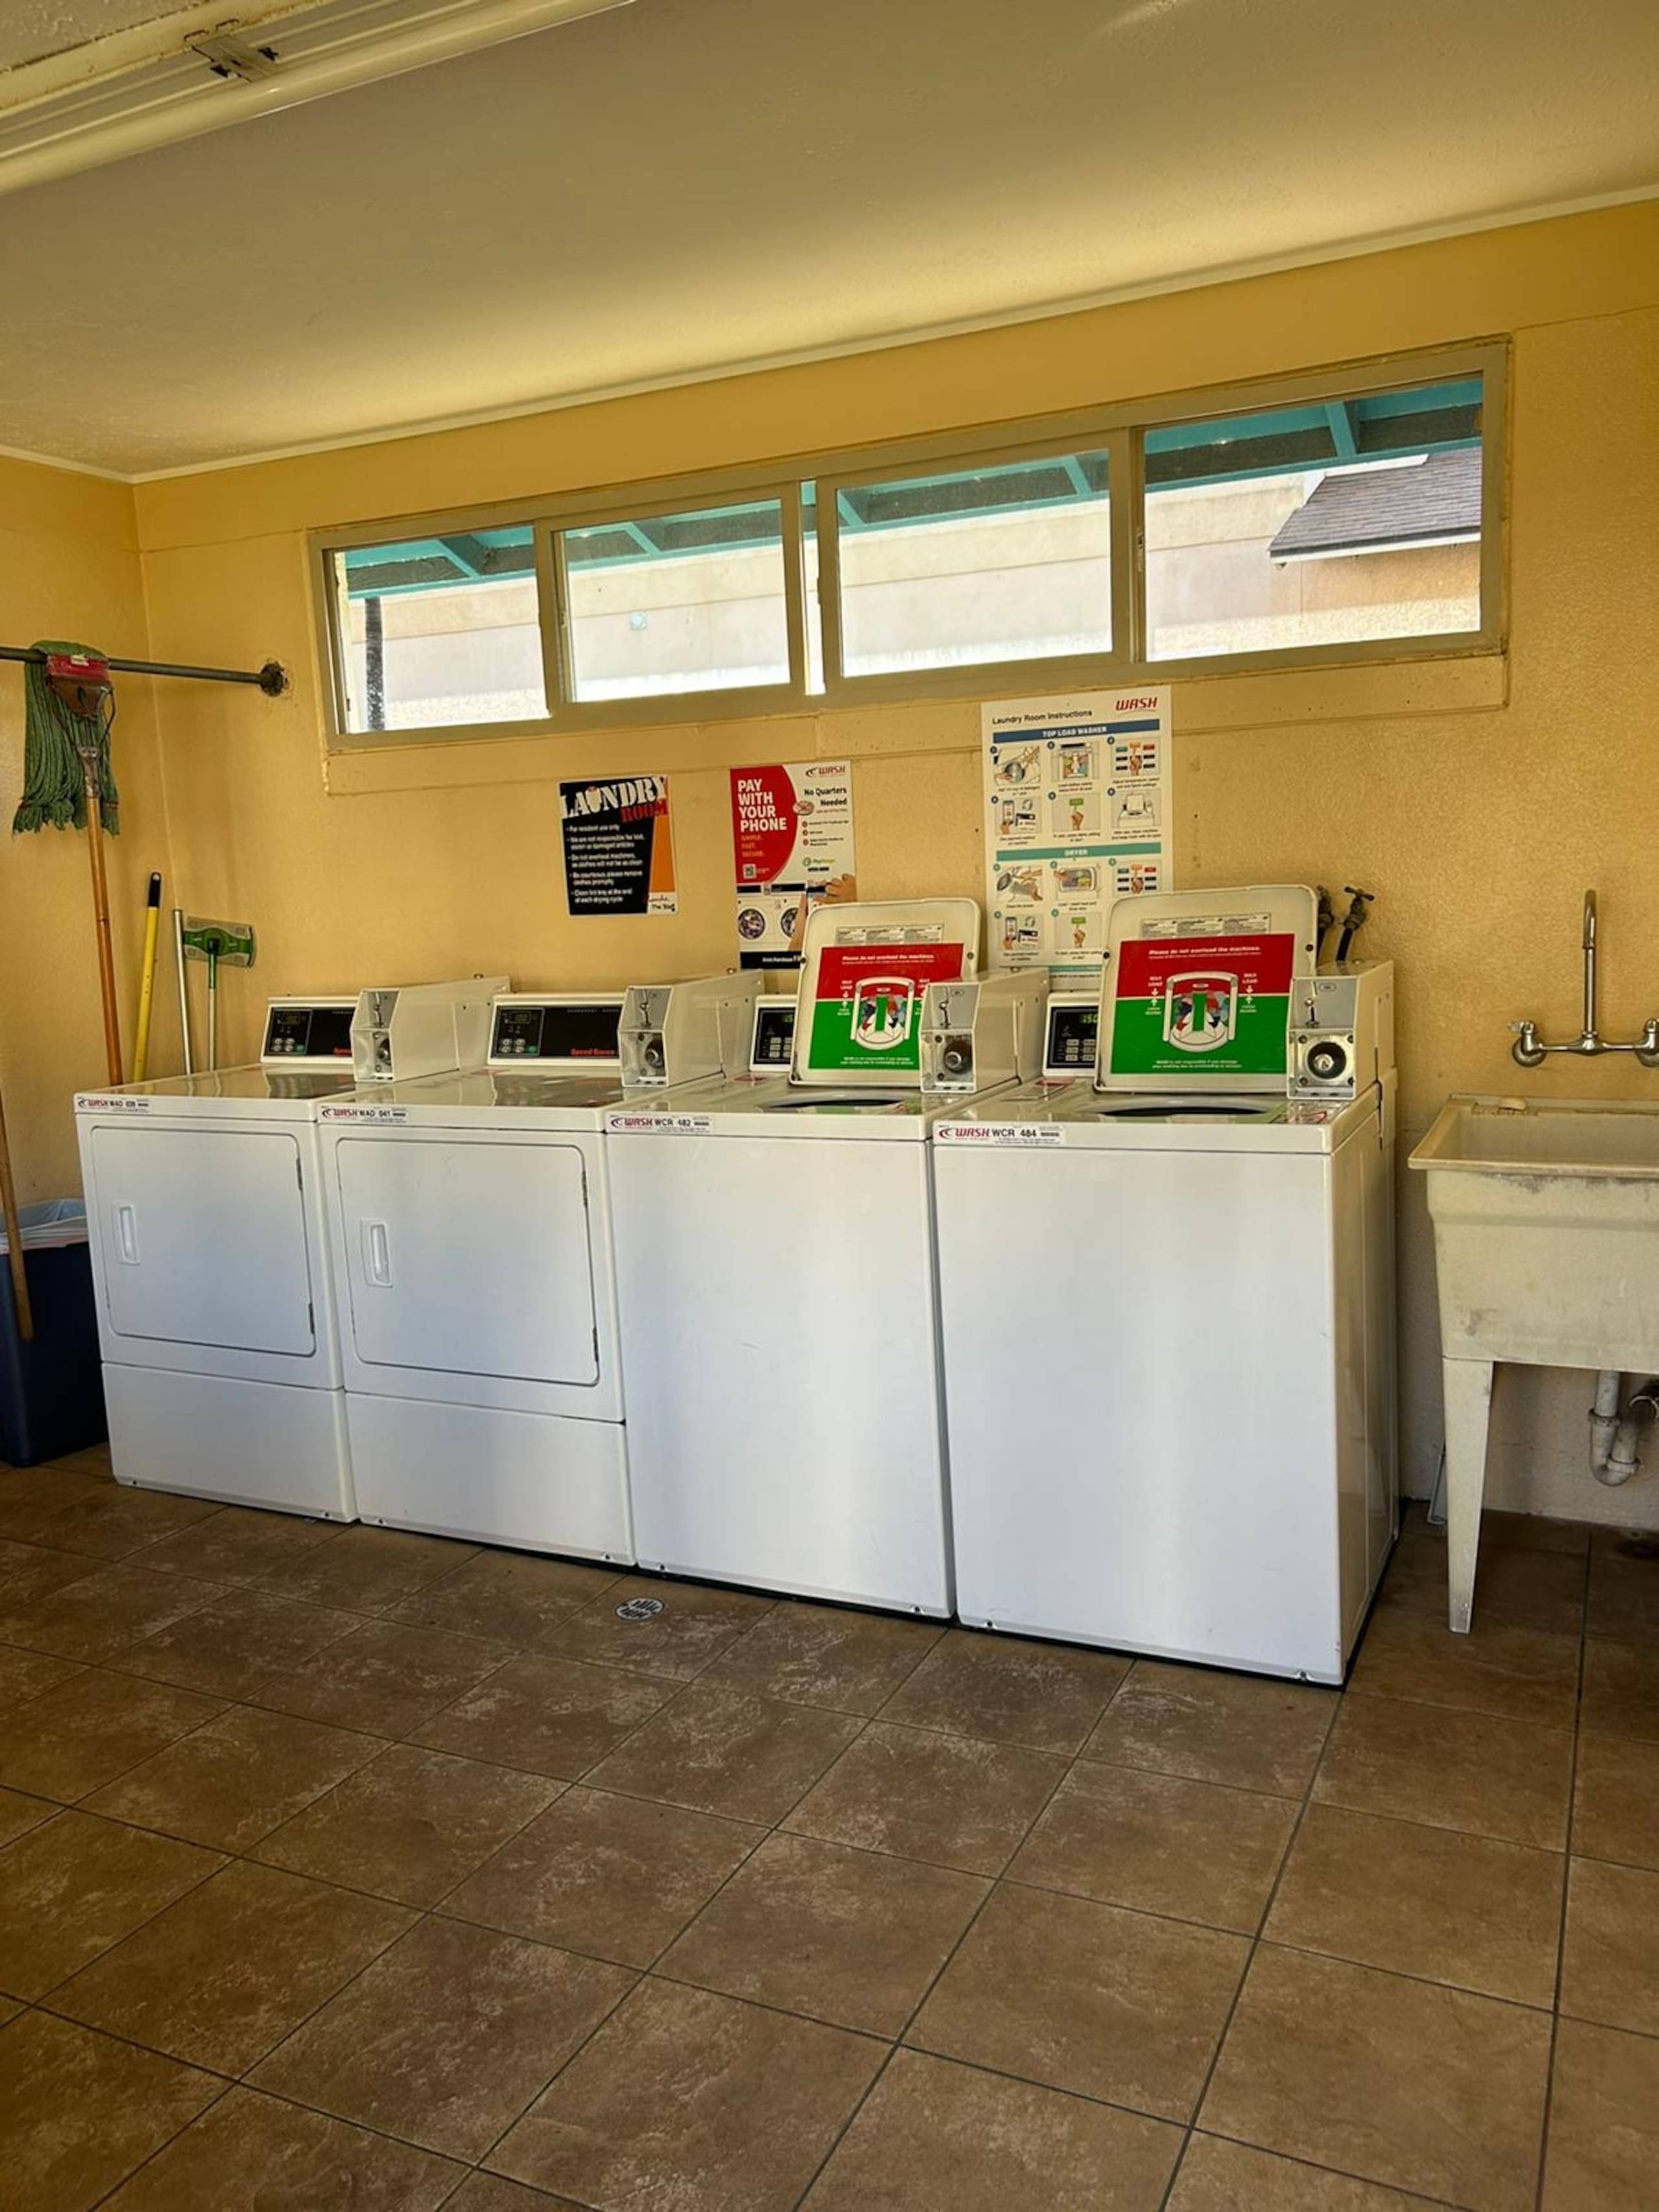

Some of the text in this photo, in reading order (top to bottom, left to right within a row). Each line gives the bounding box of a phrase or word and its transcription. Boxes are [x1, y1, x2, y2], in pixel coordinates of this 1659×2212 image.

[1115, 697, 1158, 711] WASH
[992, 716, 1022, 725] Laundry
[1047, 710, 1093, 719] Instructions
[1077, 726, 1108, 735] WASHER
[818, 766, 846, 774] WASH
[737, 778, 762, 792] PAY
[816, 787, 846, 797] Quarters
[737, 791, 773, 806] WITH
[621, 800, 667, 822] ROOM
[739, 805, 776, 819] YOUR
[740, 817, 787, 832] PHONE
[571, 1048, 592, 1056] Speed
[624, 1117, 653, 1126] WASH
[955, 1128, 1037, 1138] WASH WCR 484
